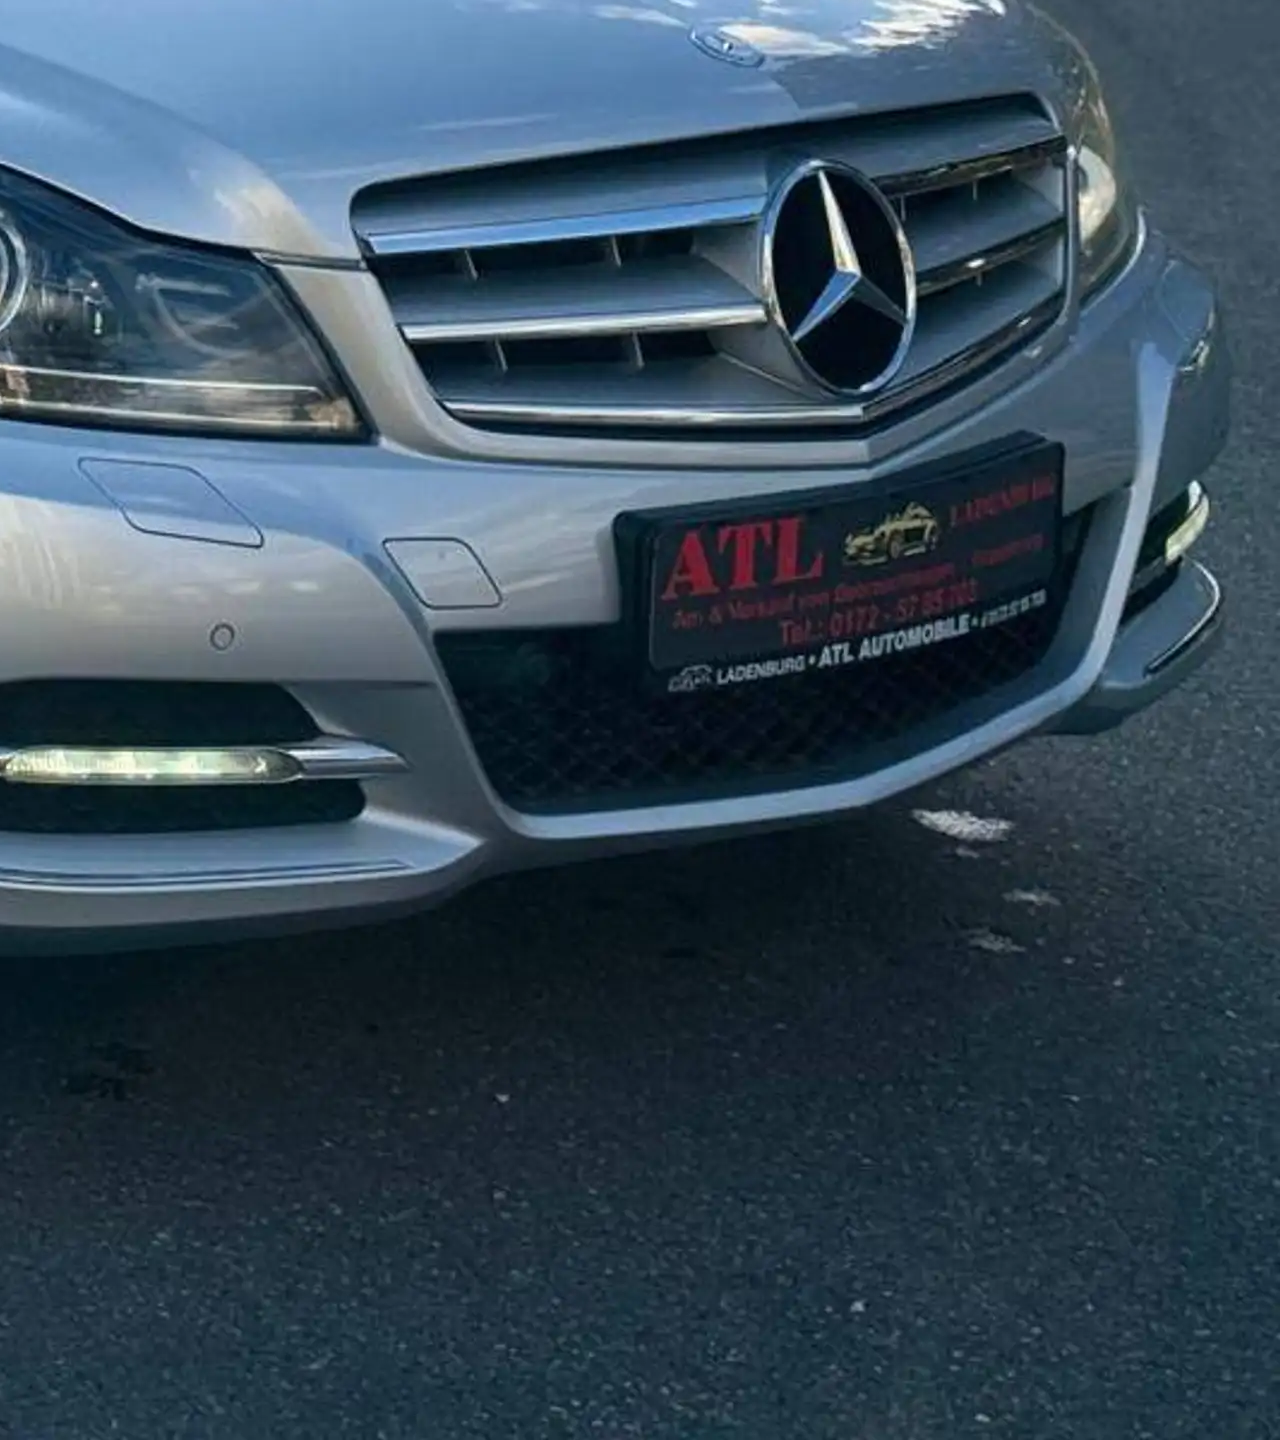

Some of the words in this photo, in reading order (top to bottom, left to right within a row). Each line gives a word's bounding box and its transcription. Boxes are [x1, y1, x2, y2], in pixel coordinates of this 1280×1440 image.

[661, 517, 824, 601] ATL
[715, 654, 806, 686] LADENBURG
[817, 641, 855, 669] ATL
[858, 614, 971, 660] AUTOMOBILE
